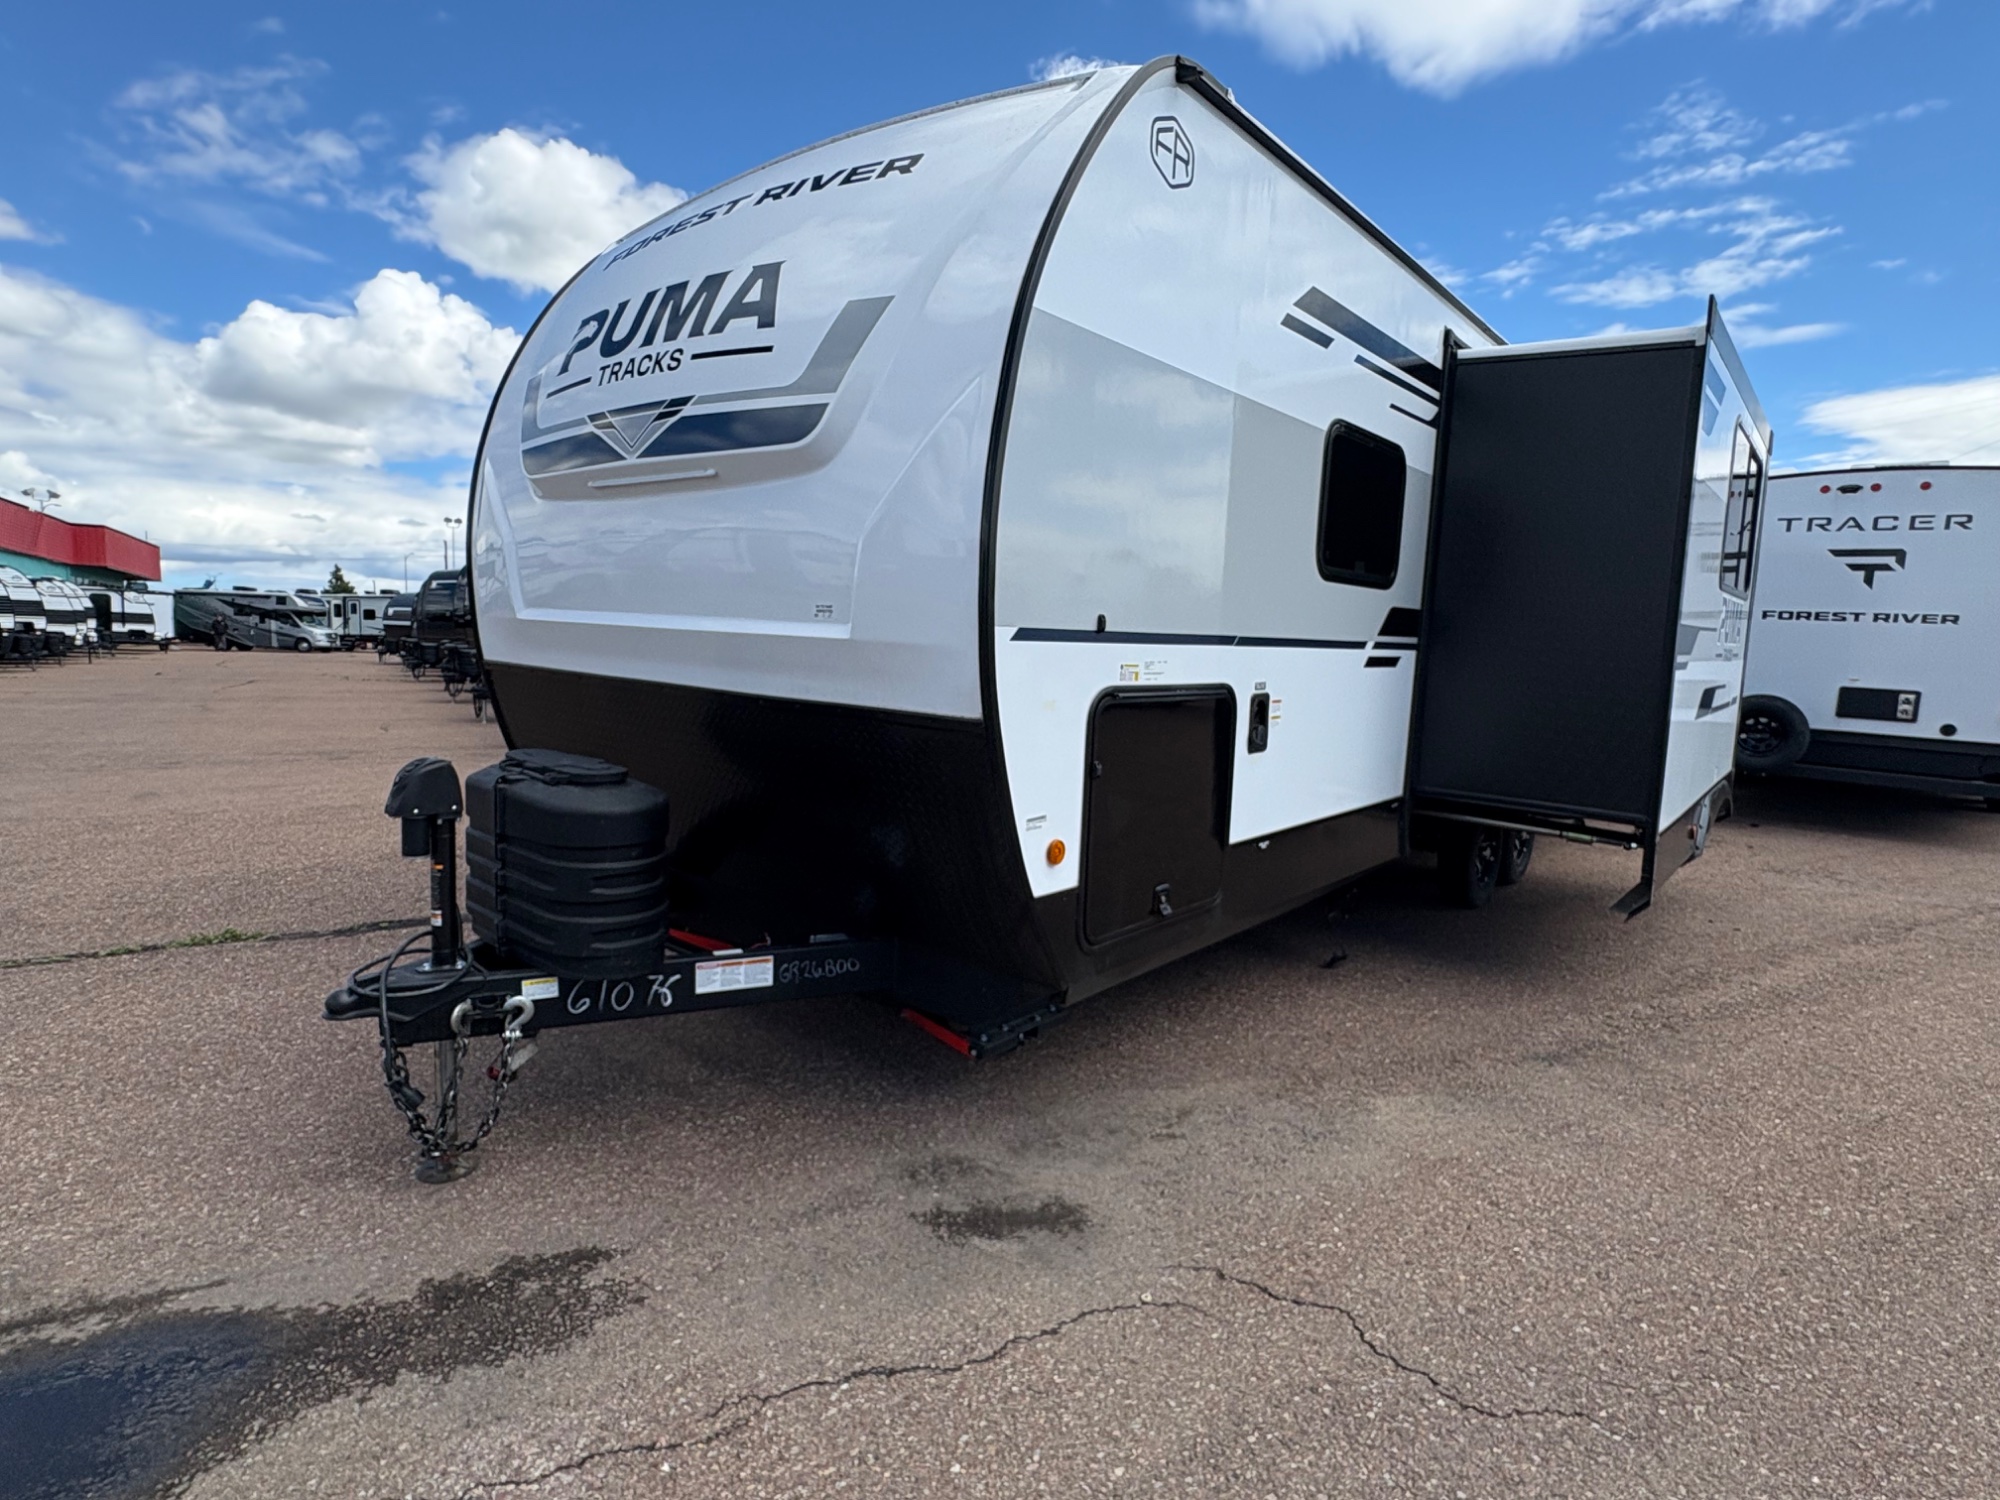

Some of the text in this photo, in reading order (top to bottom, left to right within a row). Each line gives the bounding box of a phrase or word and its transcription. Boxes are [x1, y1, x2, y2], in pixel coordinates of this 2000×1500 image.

[603, 153, 925, 271] FOREST RIVER
[556, 260, 787, 377] PUMA
[598, 348, 684, 387] TRACKS
[1777, 514, 1974, 533] TRACER
[1761, 609, 1961, 625] FOREST RIVER
